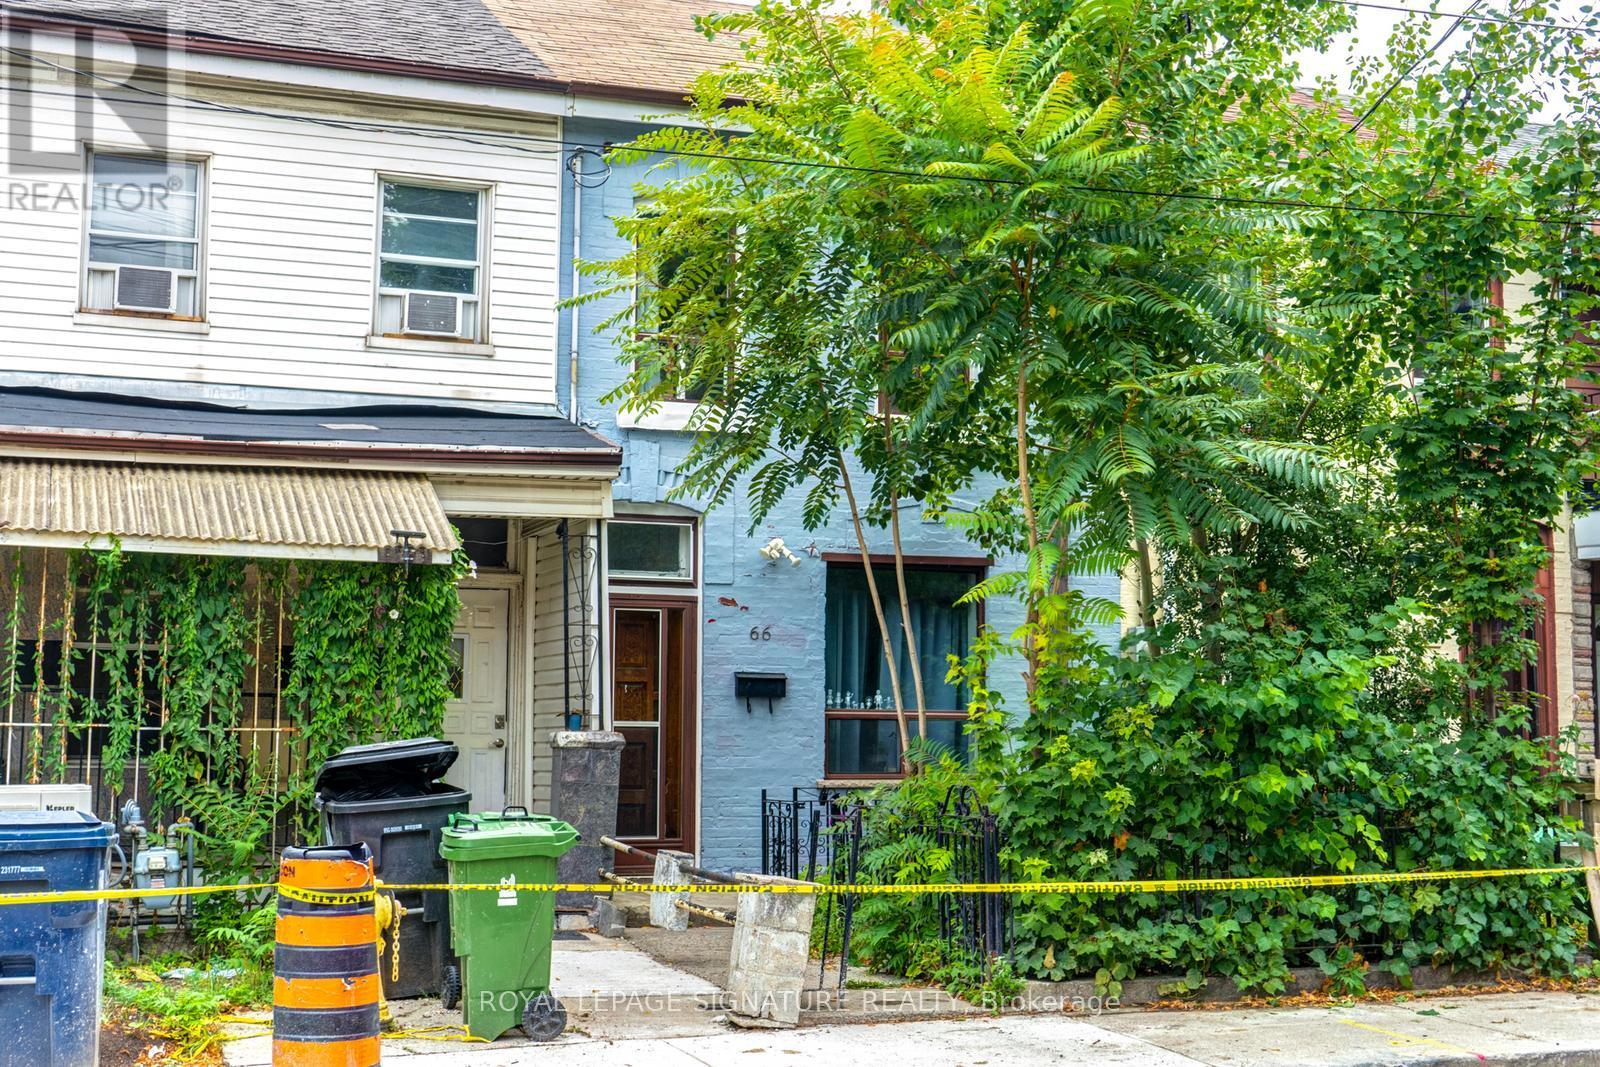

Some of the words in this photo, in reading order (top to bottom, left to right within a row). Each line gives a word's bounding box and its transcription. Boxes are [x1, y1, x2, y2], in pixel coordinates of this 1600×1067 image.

[750, 626, 771, 642] 66
[46, 804, 75, 812] KEPLER
[611, 885, 690, 893] CAUTION
[695, 885, 773, 893] CAUTION
[1074, 883, 1143, 893] CAUTION
[1177, 881, 1243, 891] CAUTION
[1246, 878, 1312, 890] CAUTION
